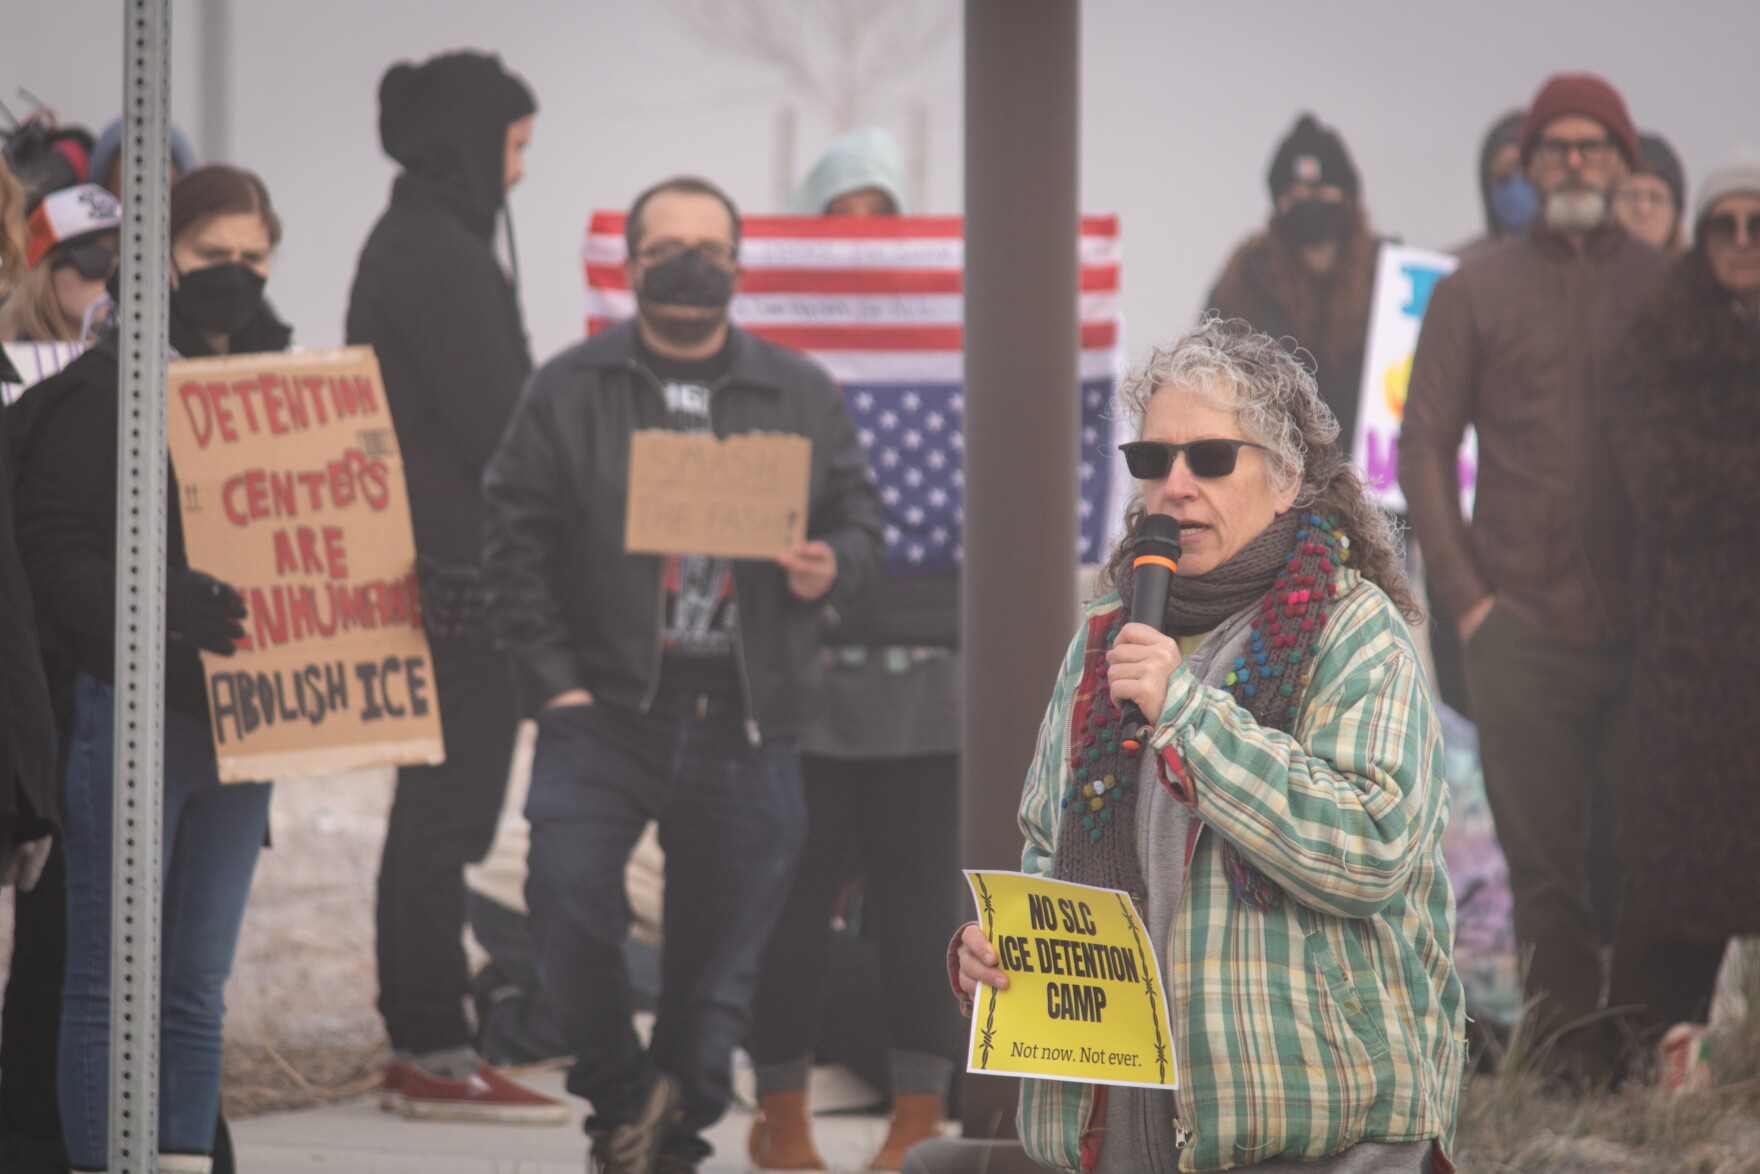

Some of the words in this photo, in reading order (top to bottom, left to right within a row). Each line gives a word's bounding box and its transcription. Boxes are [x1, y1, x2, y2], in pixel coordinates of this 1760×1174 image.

[179, 374, 378, 449] DETENTION
[222, 449, 390, 526] CENTERS
[273, 527, 348, 579] ARE
[231, 576, 422, 651] NHUMANE
[210, 662, 348, 744] ABOLISH
[355, 656, 429, 721] ICE
[1027, 893, 1058, 932] NO
[1058, 898, 1097, 936] SLC
[998, 934, 1034, 973] ICE
[1034, 938, 1141, 984] DETENTION
[1047, 982, 1107, 1023] CAMP
[1010, 1041, 1039, 1059] Not
[1040, 1048, 1076, 1062] now.
[1079, 1047, 1107, 1065] Not
[1108, 1052, 1142, 1067] ever.
